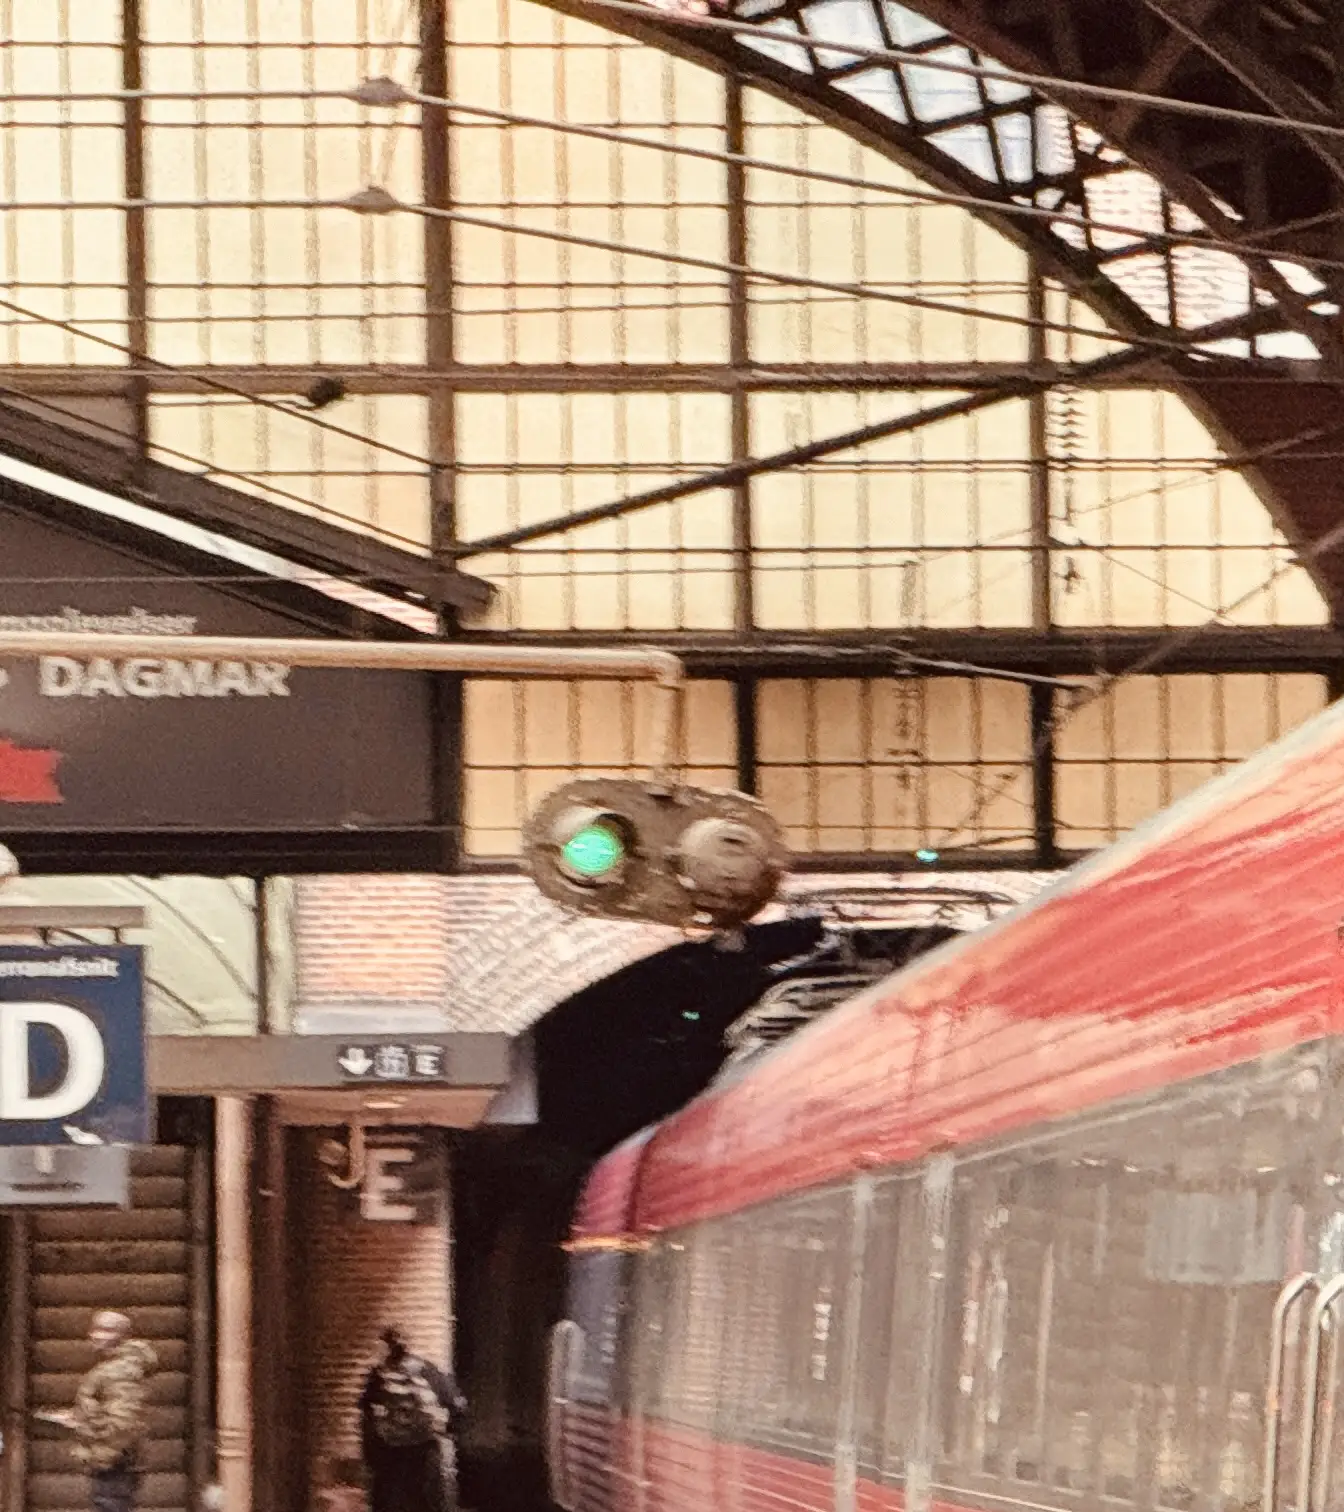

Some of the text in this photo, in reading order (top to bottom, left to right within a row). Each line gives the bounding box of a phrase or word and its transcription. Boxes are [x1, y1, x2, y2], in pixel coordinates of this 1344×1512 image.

[39, 655, 291, 697] DAGMAR
[0, 1001, 104, 1120] D
[360, 1148, 417, 1221] E
